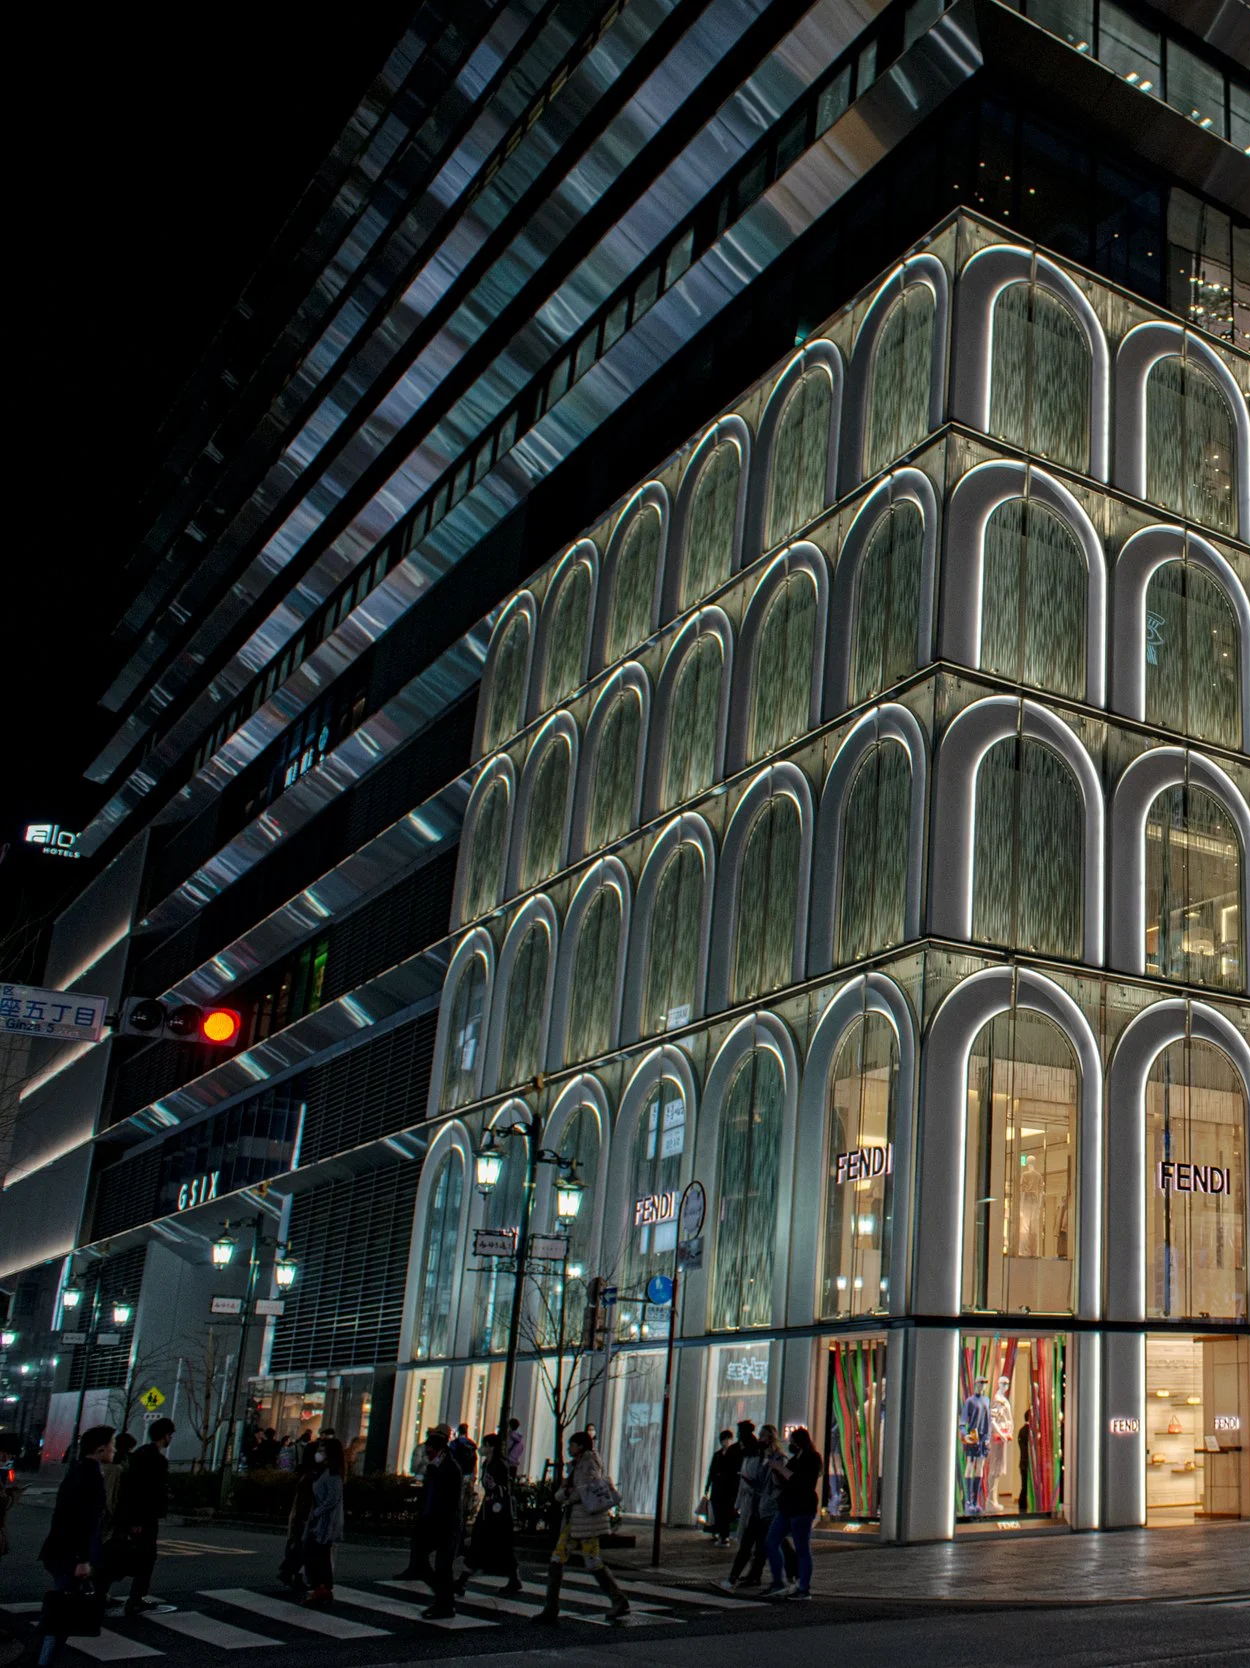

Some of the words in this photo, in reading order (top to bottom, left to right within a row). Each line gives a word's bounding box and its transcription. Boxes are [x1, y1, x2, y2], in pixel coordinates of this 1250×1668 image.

[25, 825, 81, 847] alo
[43, 847, 81, 859] HOTELS
[0, 997, 96, 1026] 座五丁目
[6, 1018, 41, 1032] Ginza
[834, 1142, 894, 1185] FENDI
[178, 1170, 220, 1211] GSIX
[1158, 1161, 1231, 1195] FENDI
[635, 1191, 677, 1227] FENDI
[1110, 1417, 1141, 1434] FENDI
[1214, 1416, 1240, 1430] FENDI
